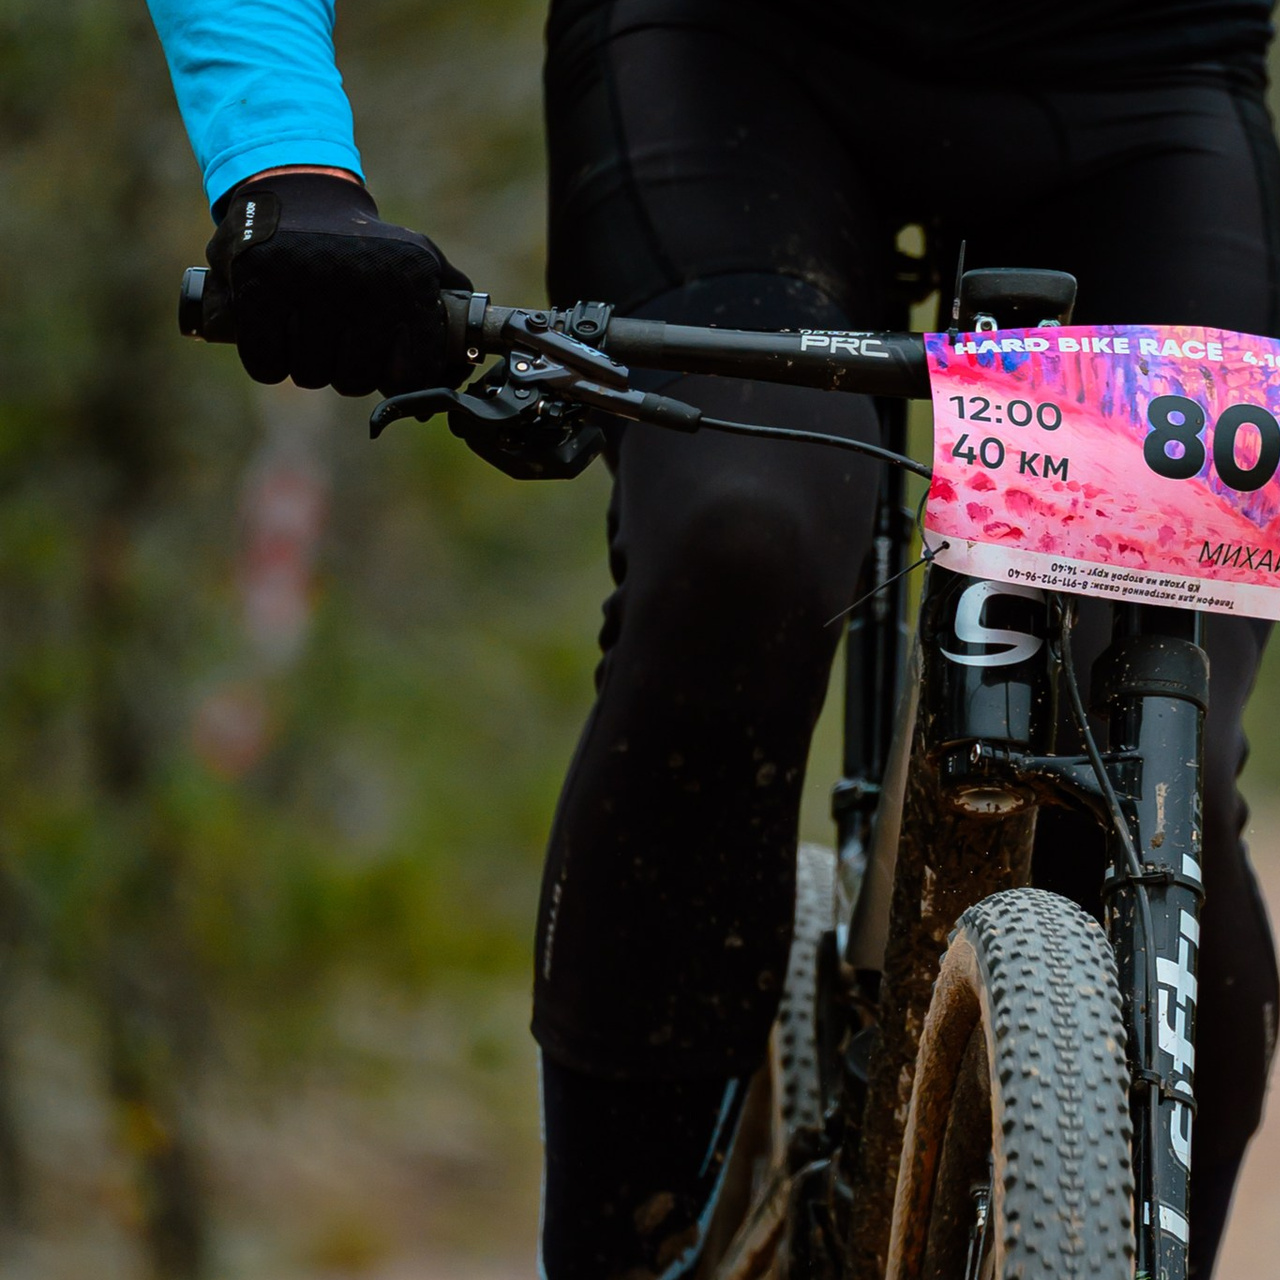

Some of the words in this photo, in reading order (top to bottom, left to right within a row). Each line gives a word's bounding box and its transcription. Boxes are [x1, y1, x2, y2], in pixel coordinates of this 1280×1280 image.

[800, 335, 889, 359] PRC
[954, 337, 1050, 355] HARD
[1058, 337, 1130, 355] BIKE
[1139, 339, 1223, 362] RACE
[949, 395, 1063, 431] 12:00
[951, 433, 1006, 470] 40
[1051, 562, 1077, 575] 14:40
[1087, 569, 1109, 580] круг
[1008, 568, 1088, 590] 8-911-912-96-40
[1111, 571, 1143, 584] второй
[1159, 578, 1187, 590] ухода
[1090, 581, 1121, 593] связи:
[1122, 585, 1176, 601] экстренной
[1178, 593, 1194, 604] для
[1196, 594, 1234, 609] Телефон
